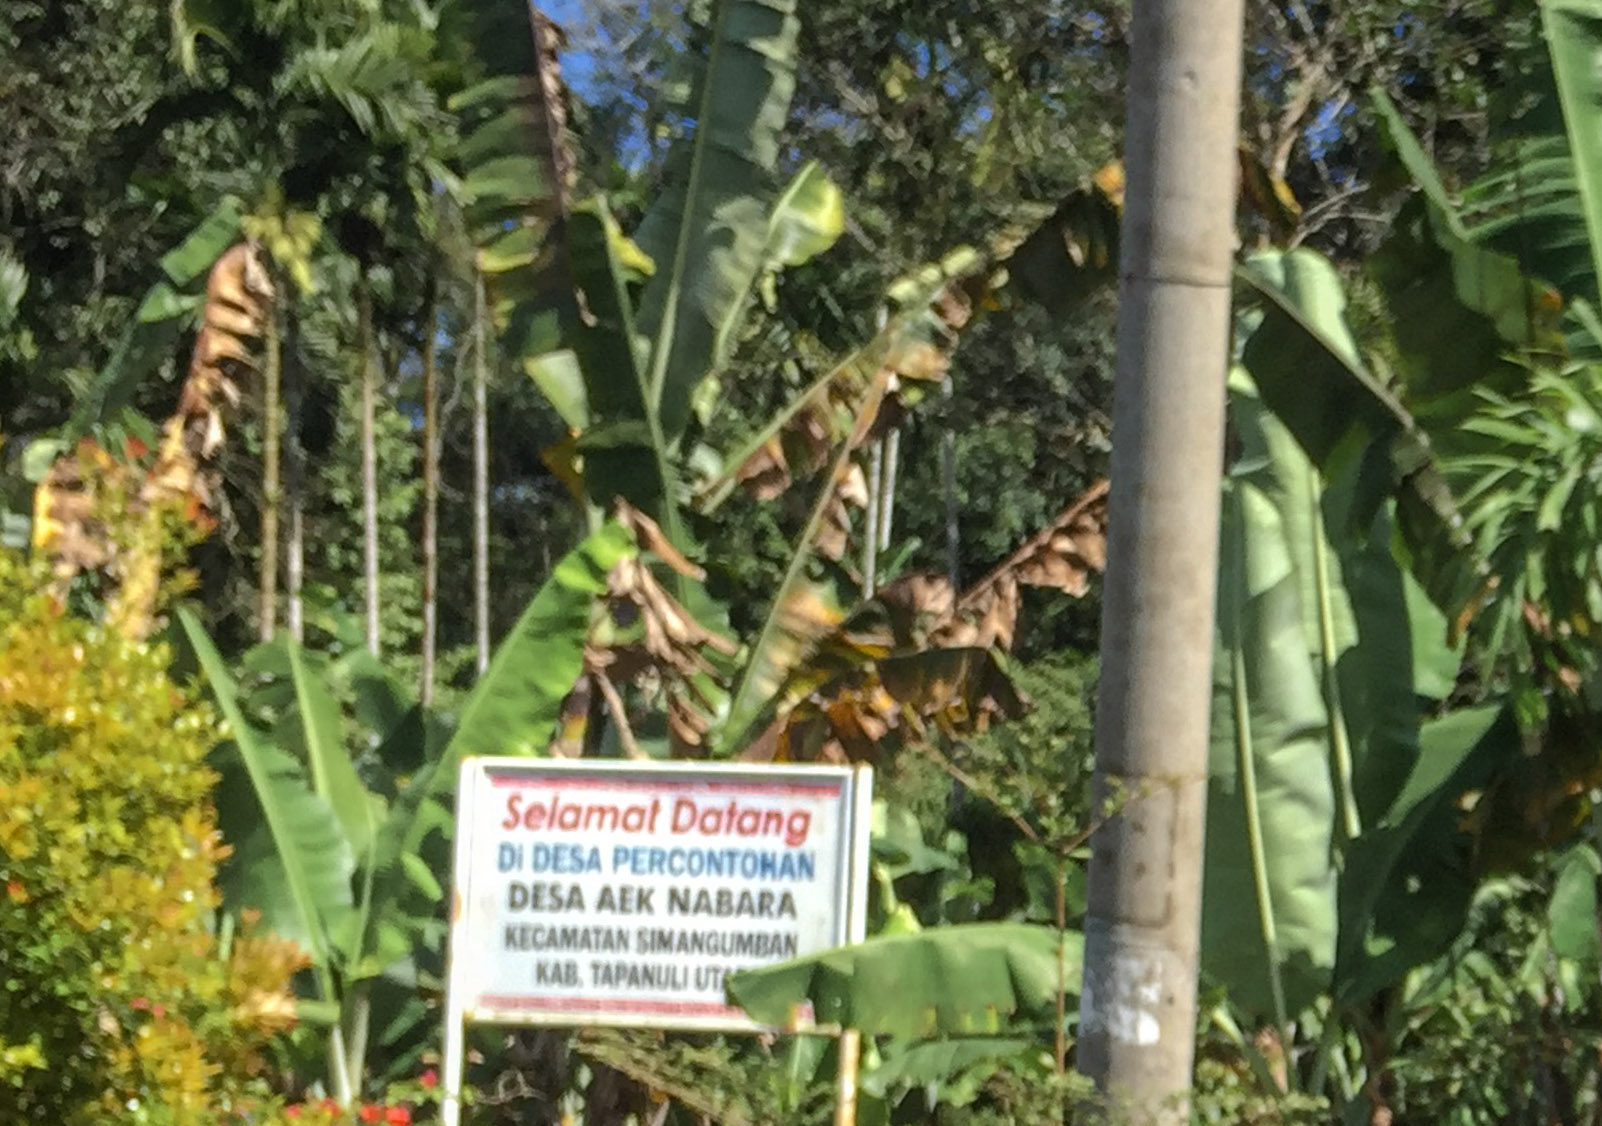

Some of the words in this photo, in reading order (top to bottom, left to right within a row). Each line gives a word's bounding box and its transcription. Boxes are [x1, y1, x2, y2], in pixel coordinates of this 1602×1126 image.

[502, 791, 660, 835] Selamat
[670, 795, 812, 848] Datang
[532, 841, 602, 874] DESA
[612, 844, 816, 882] PERCONTOHAN
[508, 882, 586, 912] DESA
[596, 885, 655, 914] AEK
[667, 886, 798, 919] NABARA
[504, 923, 630, 953] KECAMATAN
[636, 926, 799, 959] SIMANGUMBAN
[535, 959, 583, 988] KAB.
[590, 961, 689, 992] TAPANULI
